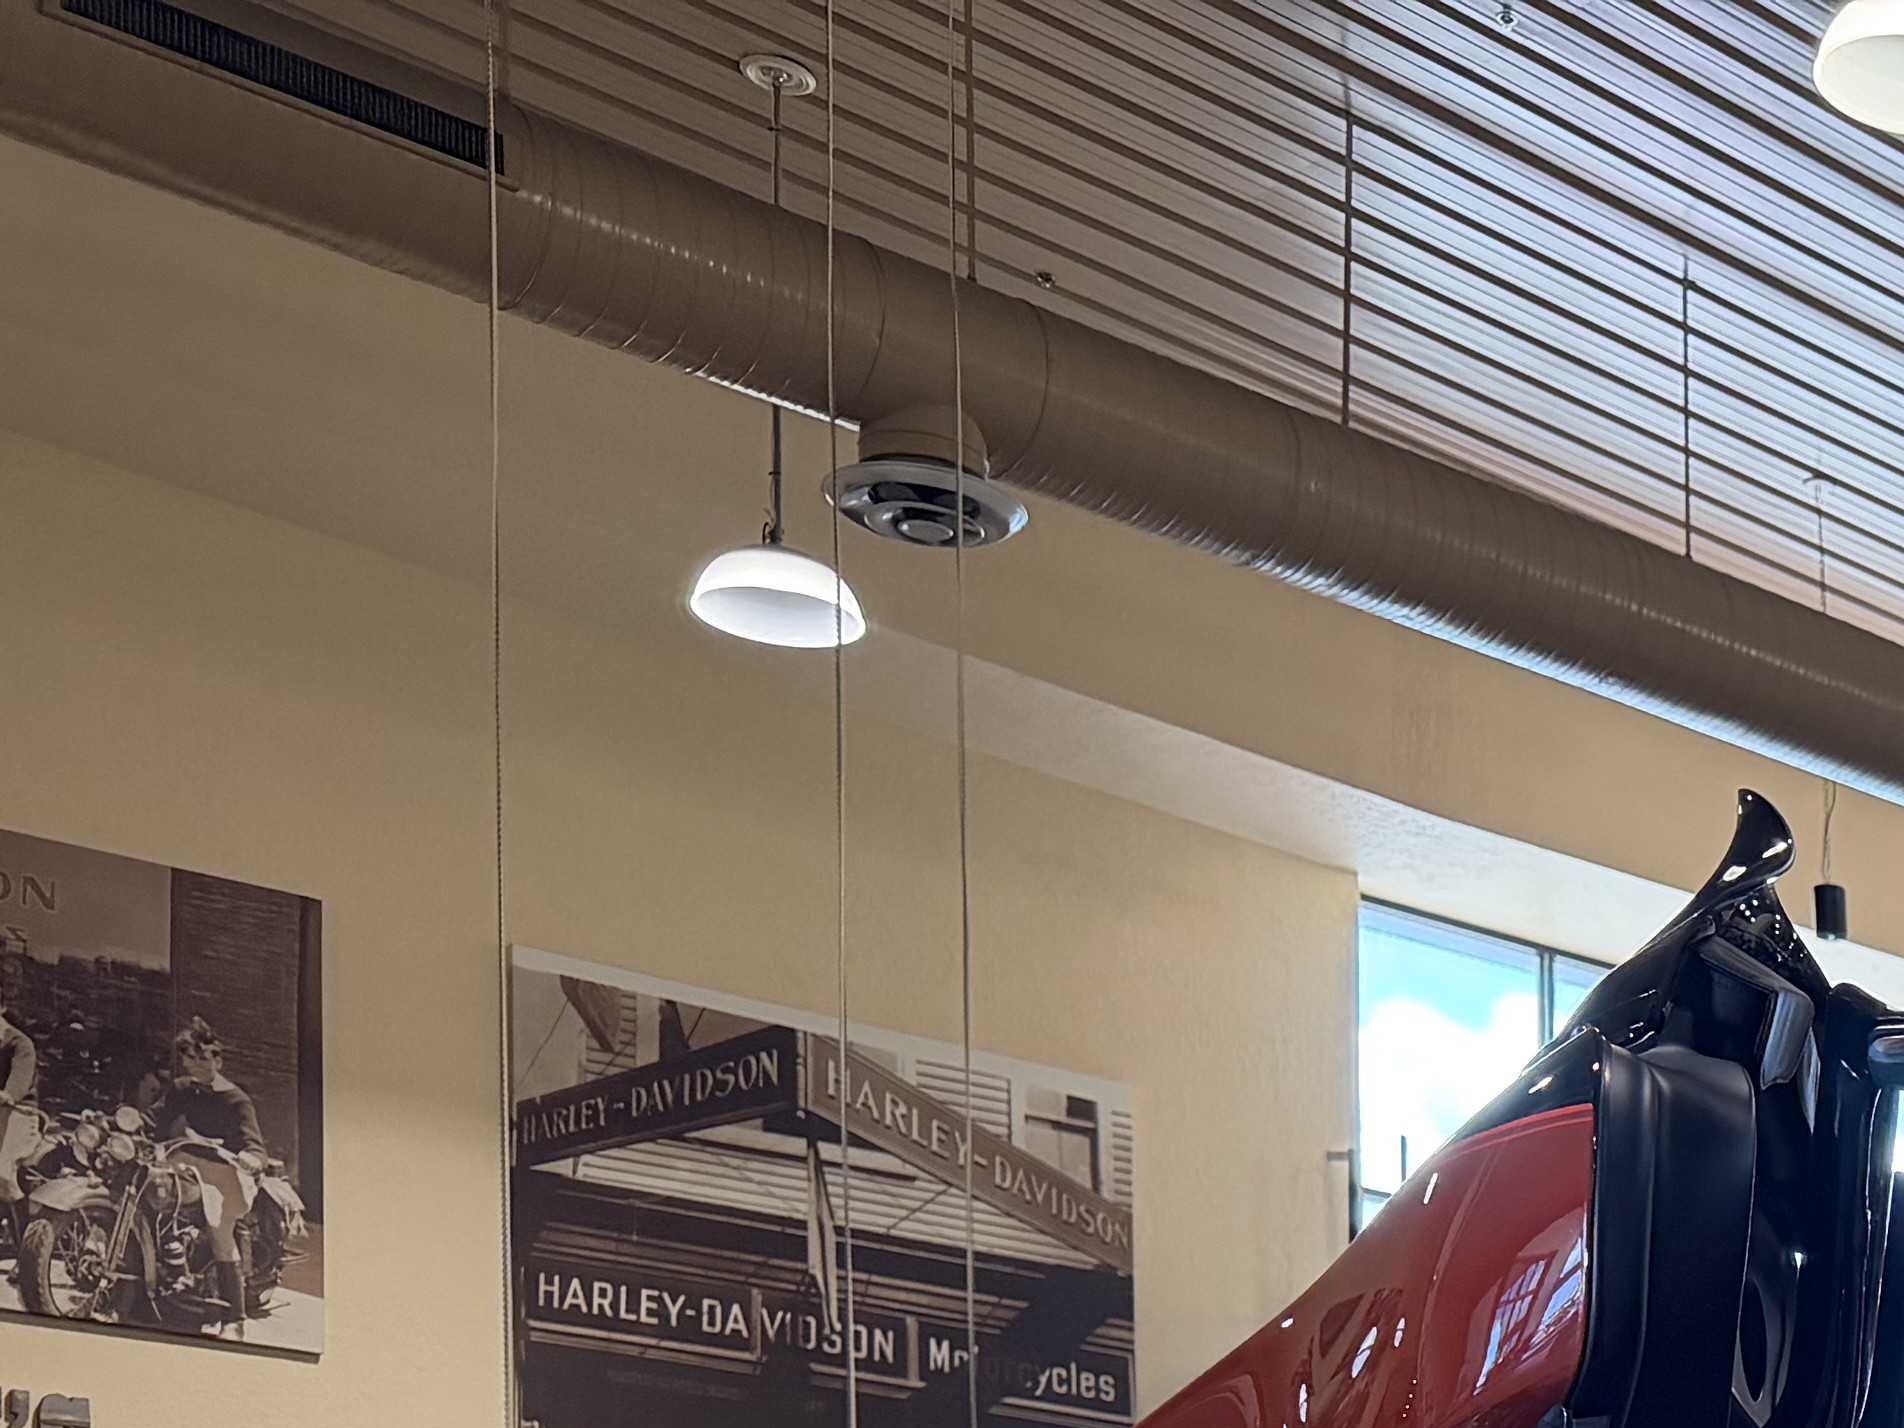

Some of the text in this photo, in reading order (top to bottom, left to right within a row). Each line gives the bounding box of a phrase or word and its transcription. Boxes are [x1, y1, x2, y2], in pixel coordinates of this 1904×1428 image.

[522, 1048, 779, 1145] HARLEY-DAVIDSON
[826, 1057, 1129, 1250] HARLEY-DAVIDSON
[538, 1271, 895, 1365] HARLEY-DAVIDSON
